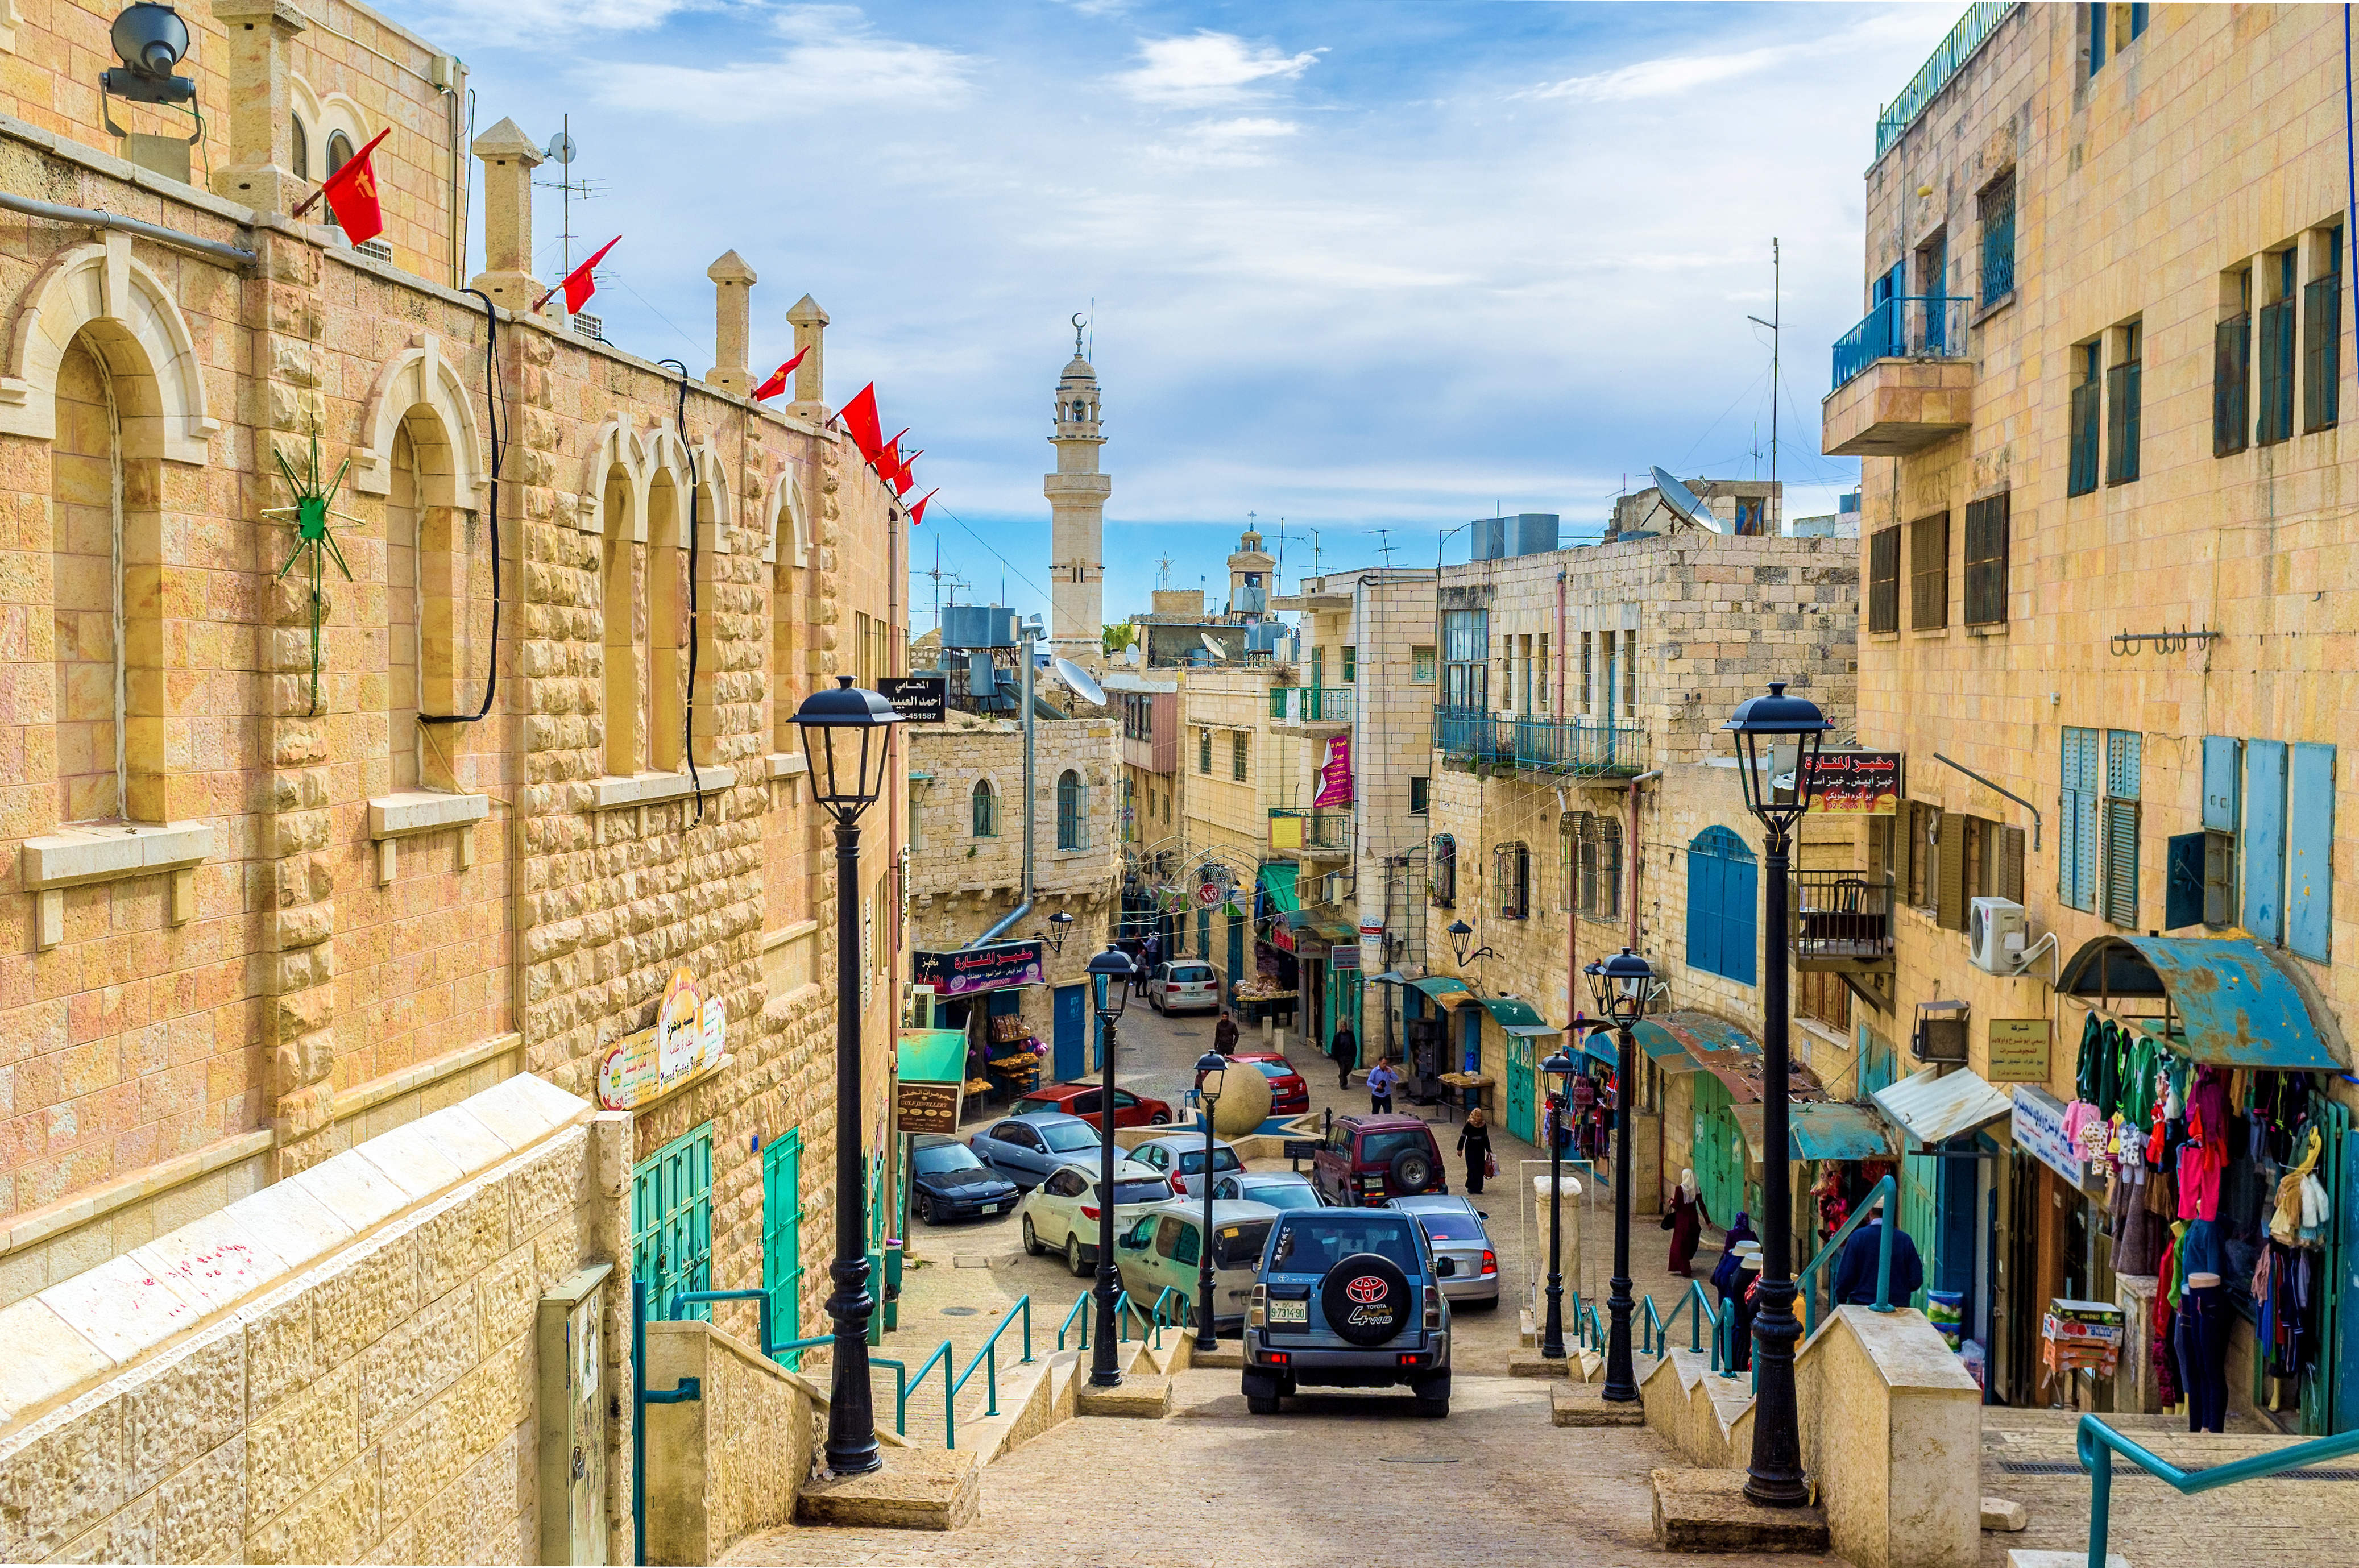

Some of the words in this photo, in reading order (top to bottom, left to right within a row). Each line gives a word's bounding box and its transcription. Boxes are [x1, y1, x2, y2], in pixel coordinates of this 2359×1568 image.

[895, 680, 928, 693] المحامي
[887, 695, 917, 709] العبيد
[919, 694, 941, 706] أحمد
[1805, 755, 1850, 773] المنارة
[1852, 756, 1895, 773] مخبز
[1806, 775, 1825, 785] أسد
[1826, 776, 1844, 787] خبز
[1851, 775, 1874, 787] أبيض
[1875, 776, 1894, 787] خبز
[921, 957, 939, 968] مخبز
[954, 951, 995, 971] المنارة
[996, 948, 1034, 966] مخبز
[917, 973, 944, 987] المنارة
[2010, 1023, 2029, 1032] شركة
[1348, 1306, 1392, 1326] 4WD
